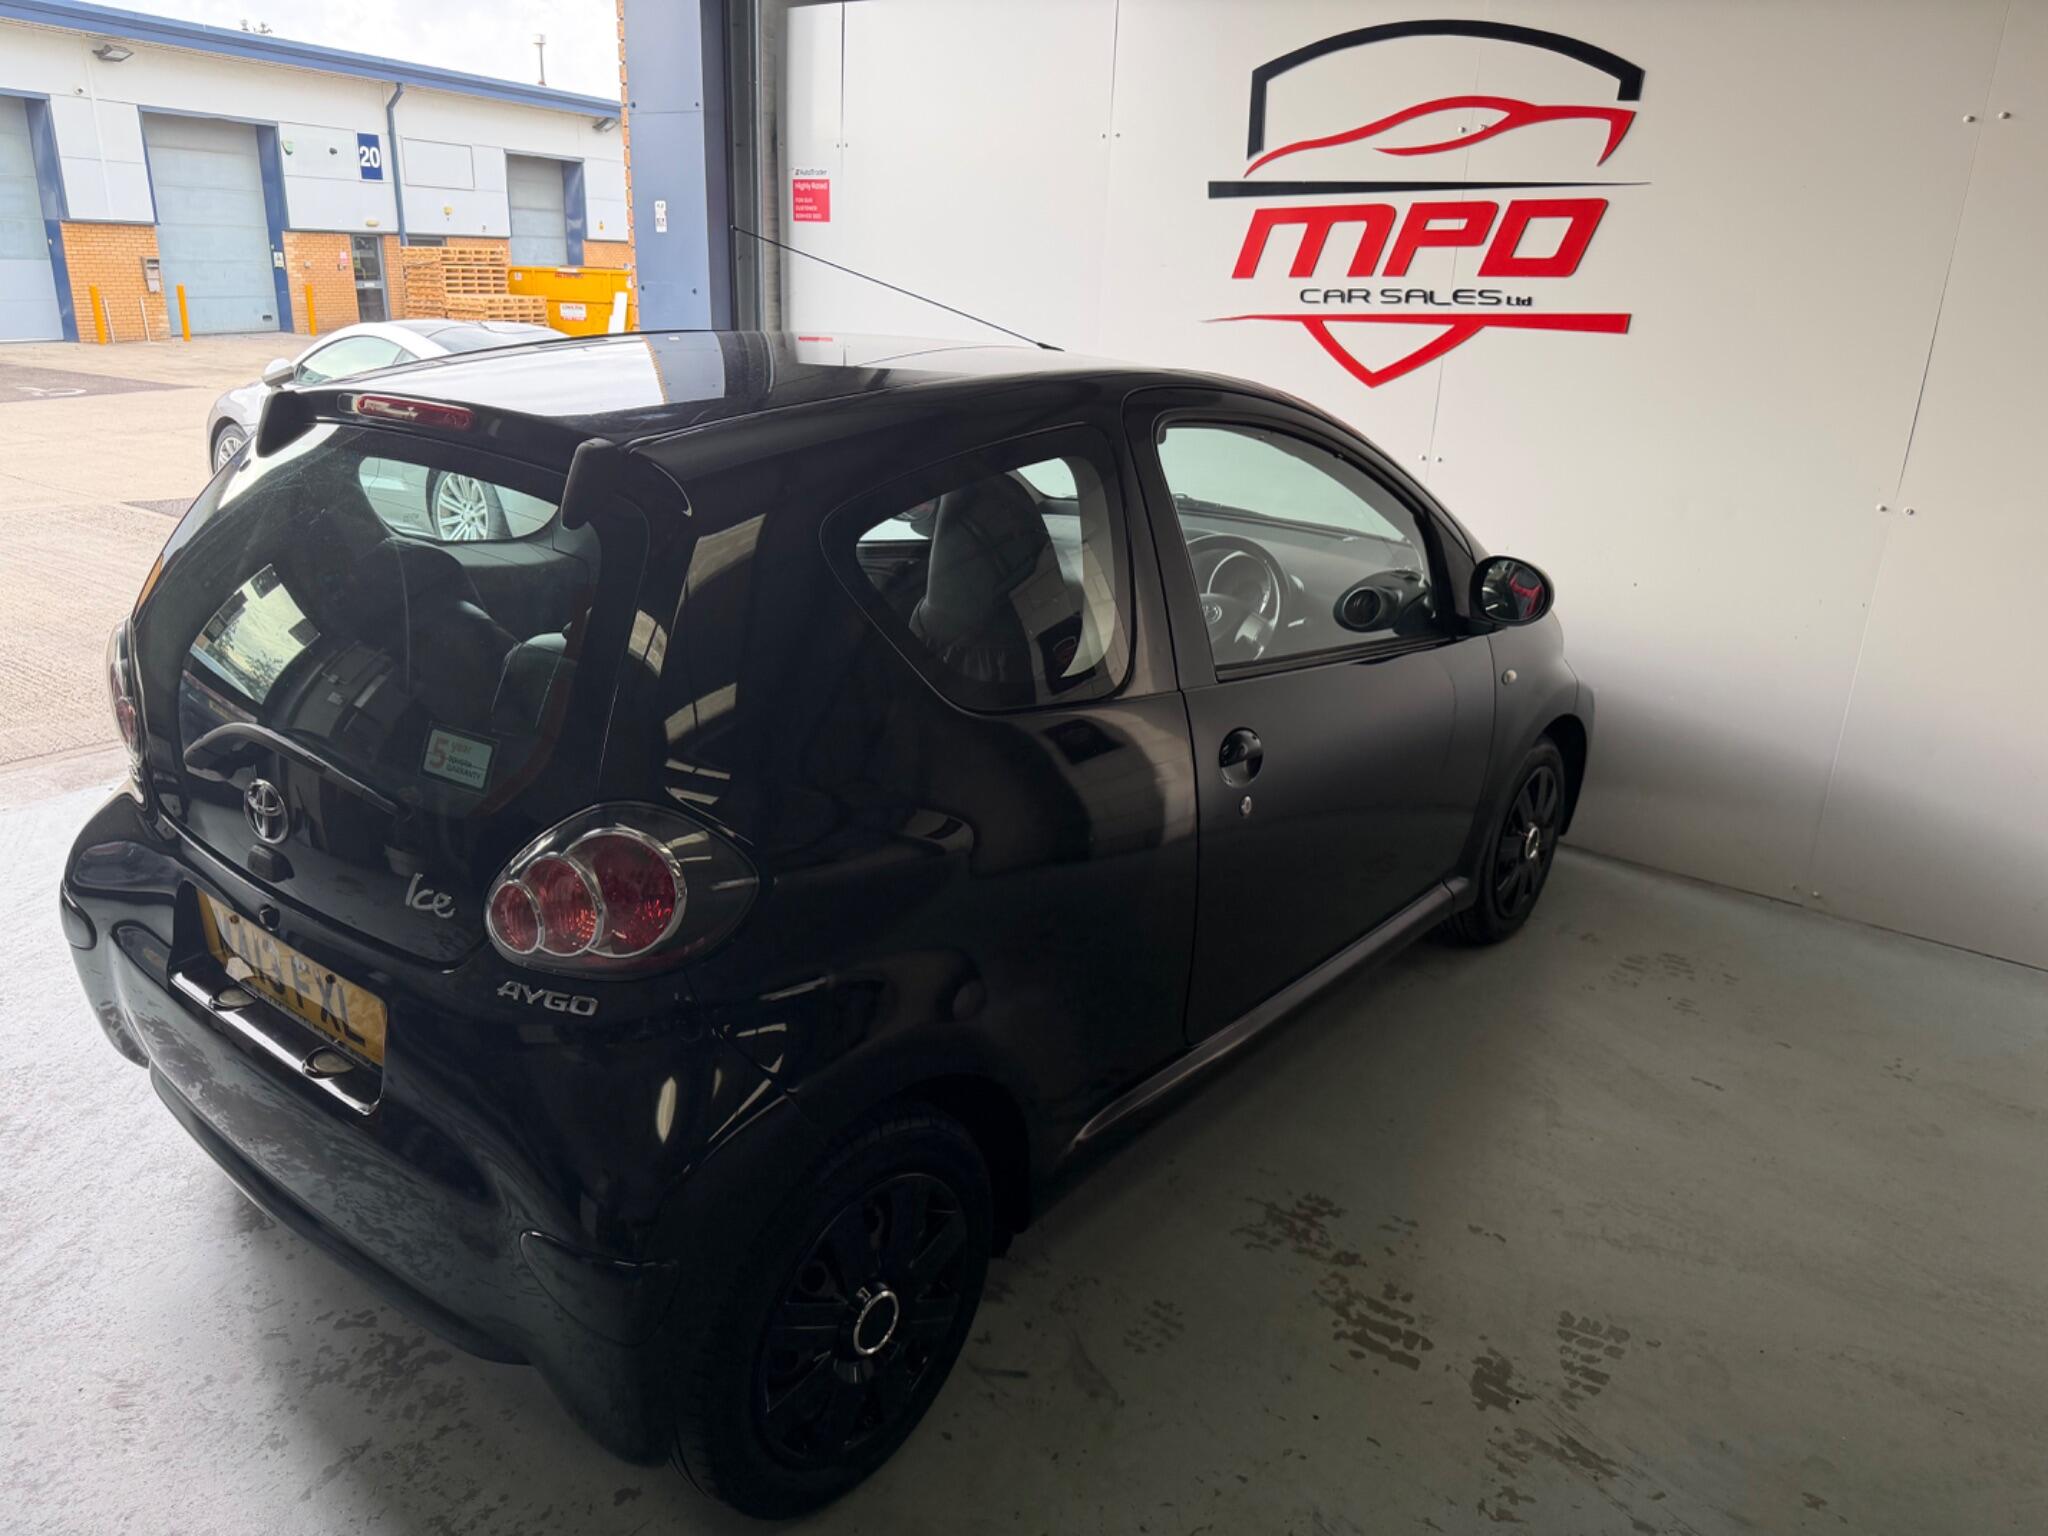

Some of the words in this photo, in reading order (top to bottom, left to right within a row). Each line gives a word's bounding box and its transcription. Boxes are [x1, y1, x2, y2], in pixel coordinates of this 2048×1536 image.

[360, 146, 380, 168] 20
[1300, 288, 1372, 305] CAR
[1380, 288, 1503, 306] SALES
[1506, 295, 1533, 307] Ltd
[405, 872, 456, 918] Ice
[497, 980, 599, 1016] AYGO
